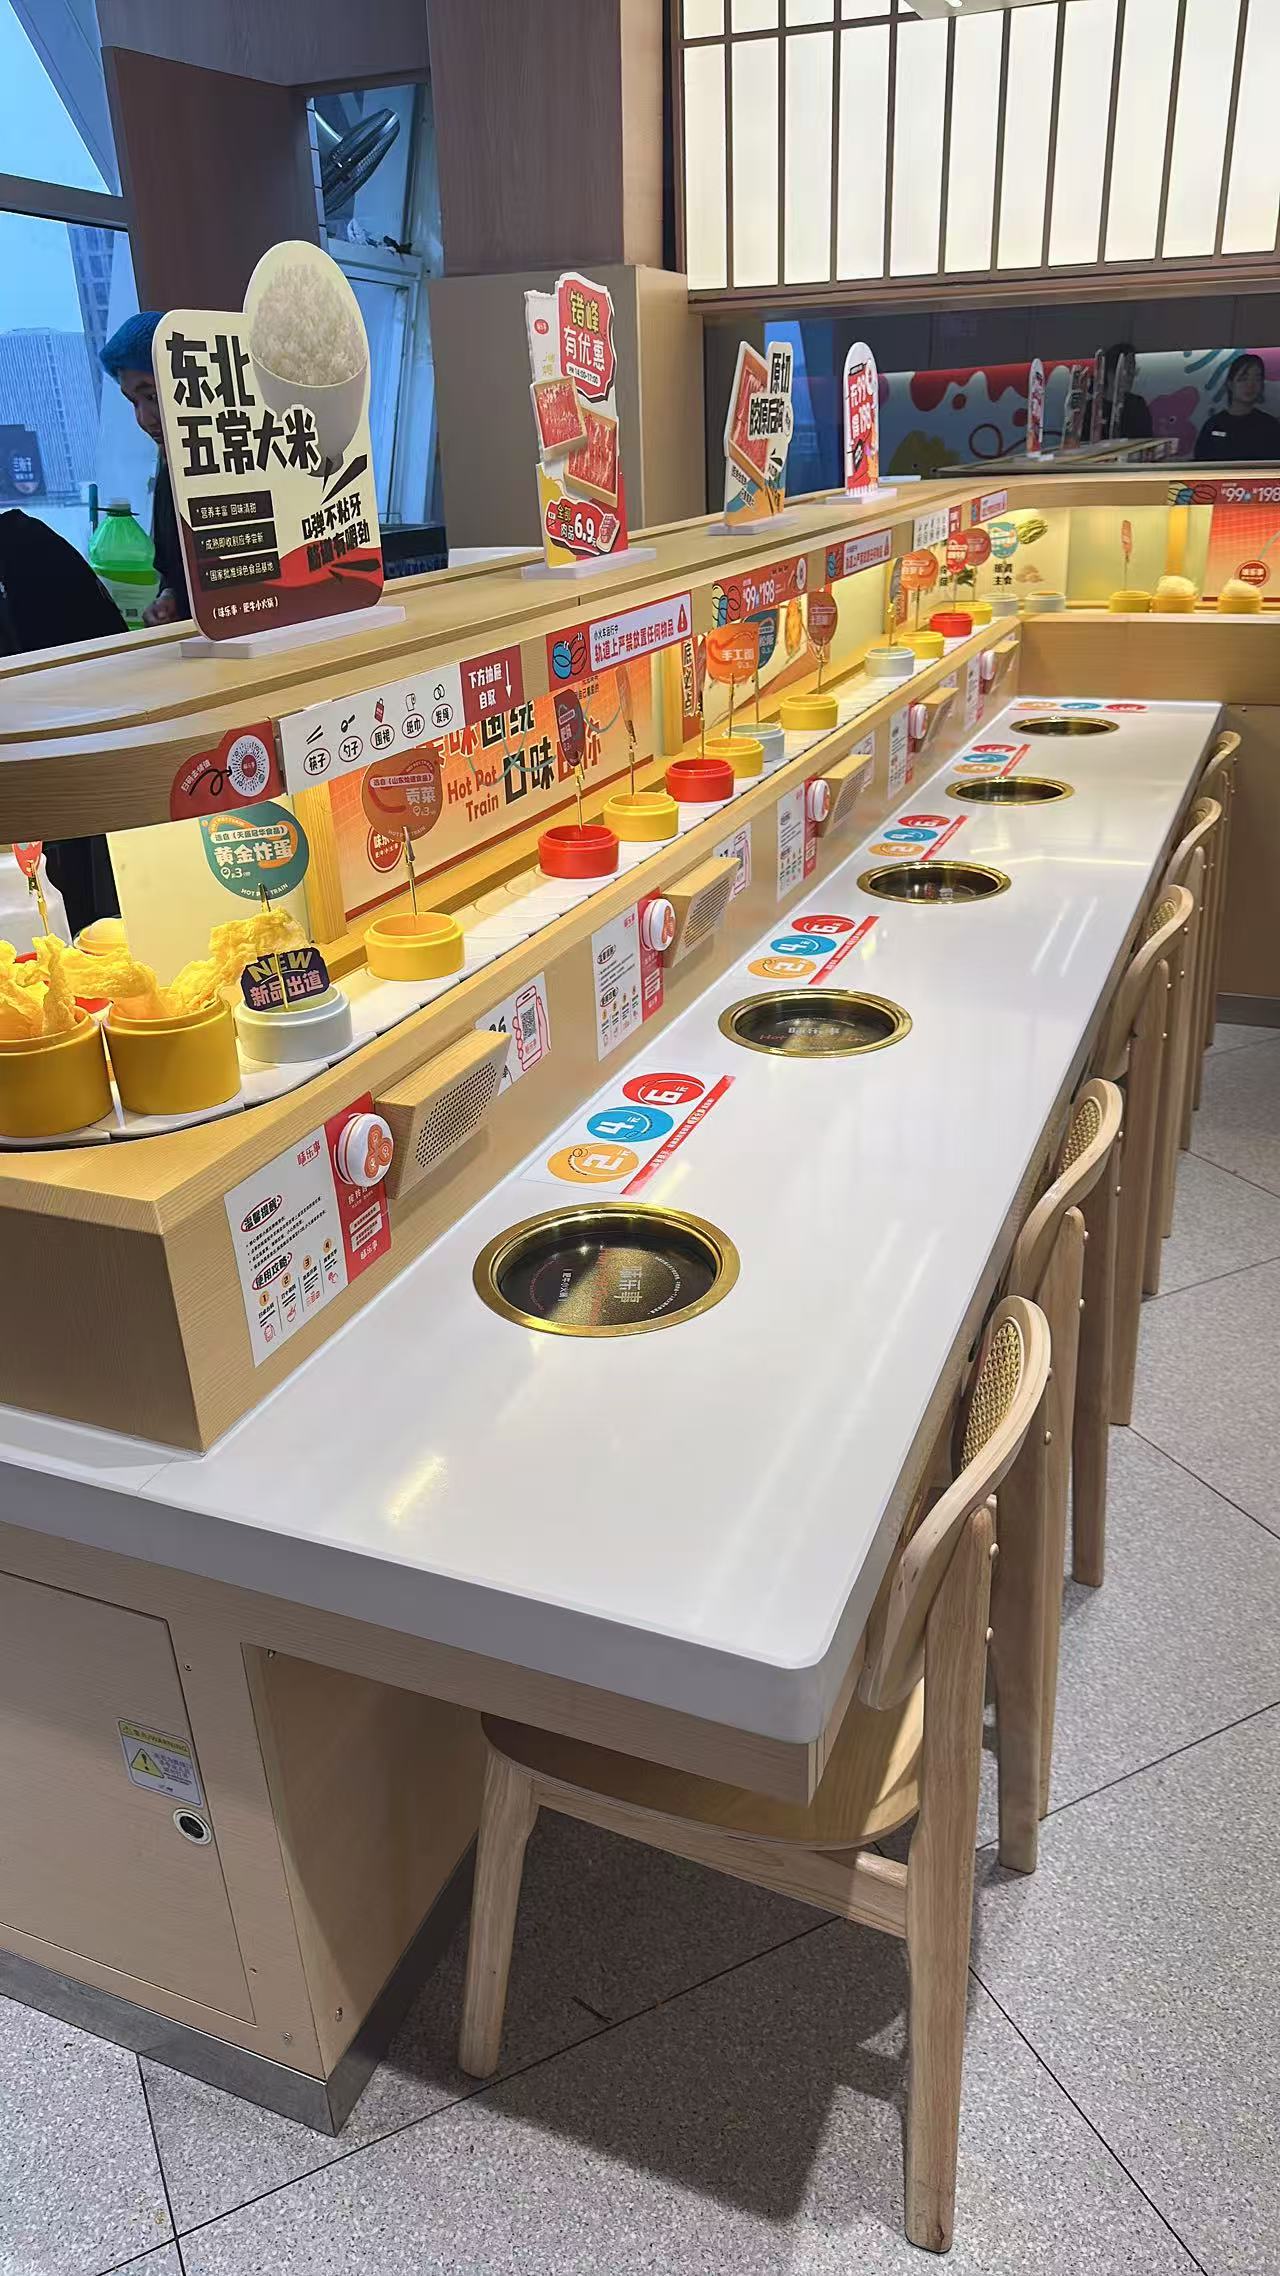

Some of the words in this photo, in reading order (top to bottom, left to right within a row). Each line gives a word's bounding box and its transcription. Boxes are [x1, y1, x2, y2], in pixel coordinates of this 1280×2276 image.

[569, 288, 600, 334] 错峰
[563, 326, 606, 372] 有优惠
[165, 331, 255, 408] 东北
[177, 409, 319, 477] 五常大米
[200, 507, 228, 519] 营养丰富
[594, 618, 675, 663] 轨道上严禁放置任何物品
[468, 663, 503, 689] 下方抽屉
[479, 689, 497, 711] 自取
[374, 729, 391, 747] 围裙
[405, 718, 421, 733] 纸巾
[308, 753, 325, 770] 筷子
[343, 740, 358, 757] 勺子
[447, 777, 472, 804] Hot
[475, 766, 497, 791] Pot
[465, 793, 498, 822] Train
[214, 839, 293, 867] 黄金炸蛋
[241, 888, 255, 896] HOT
[270, 883, 288, 895] TRAIN
[247, 951, 313, 983] NEW
[249, 969, 324, 1007] 新品出道
